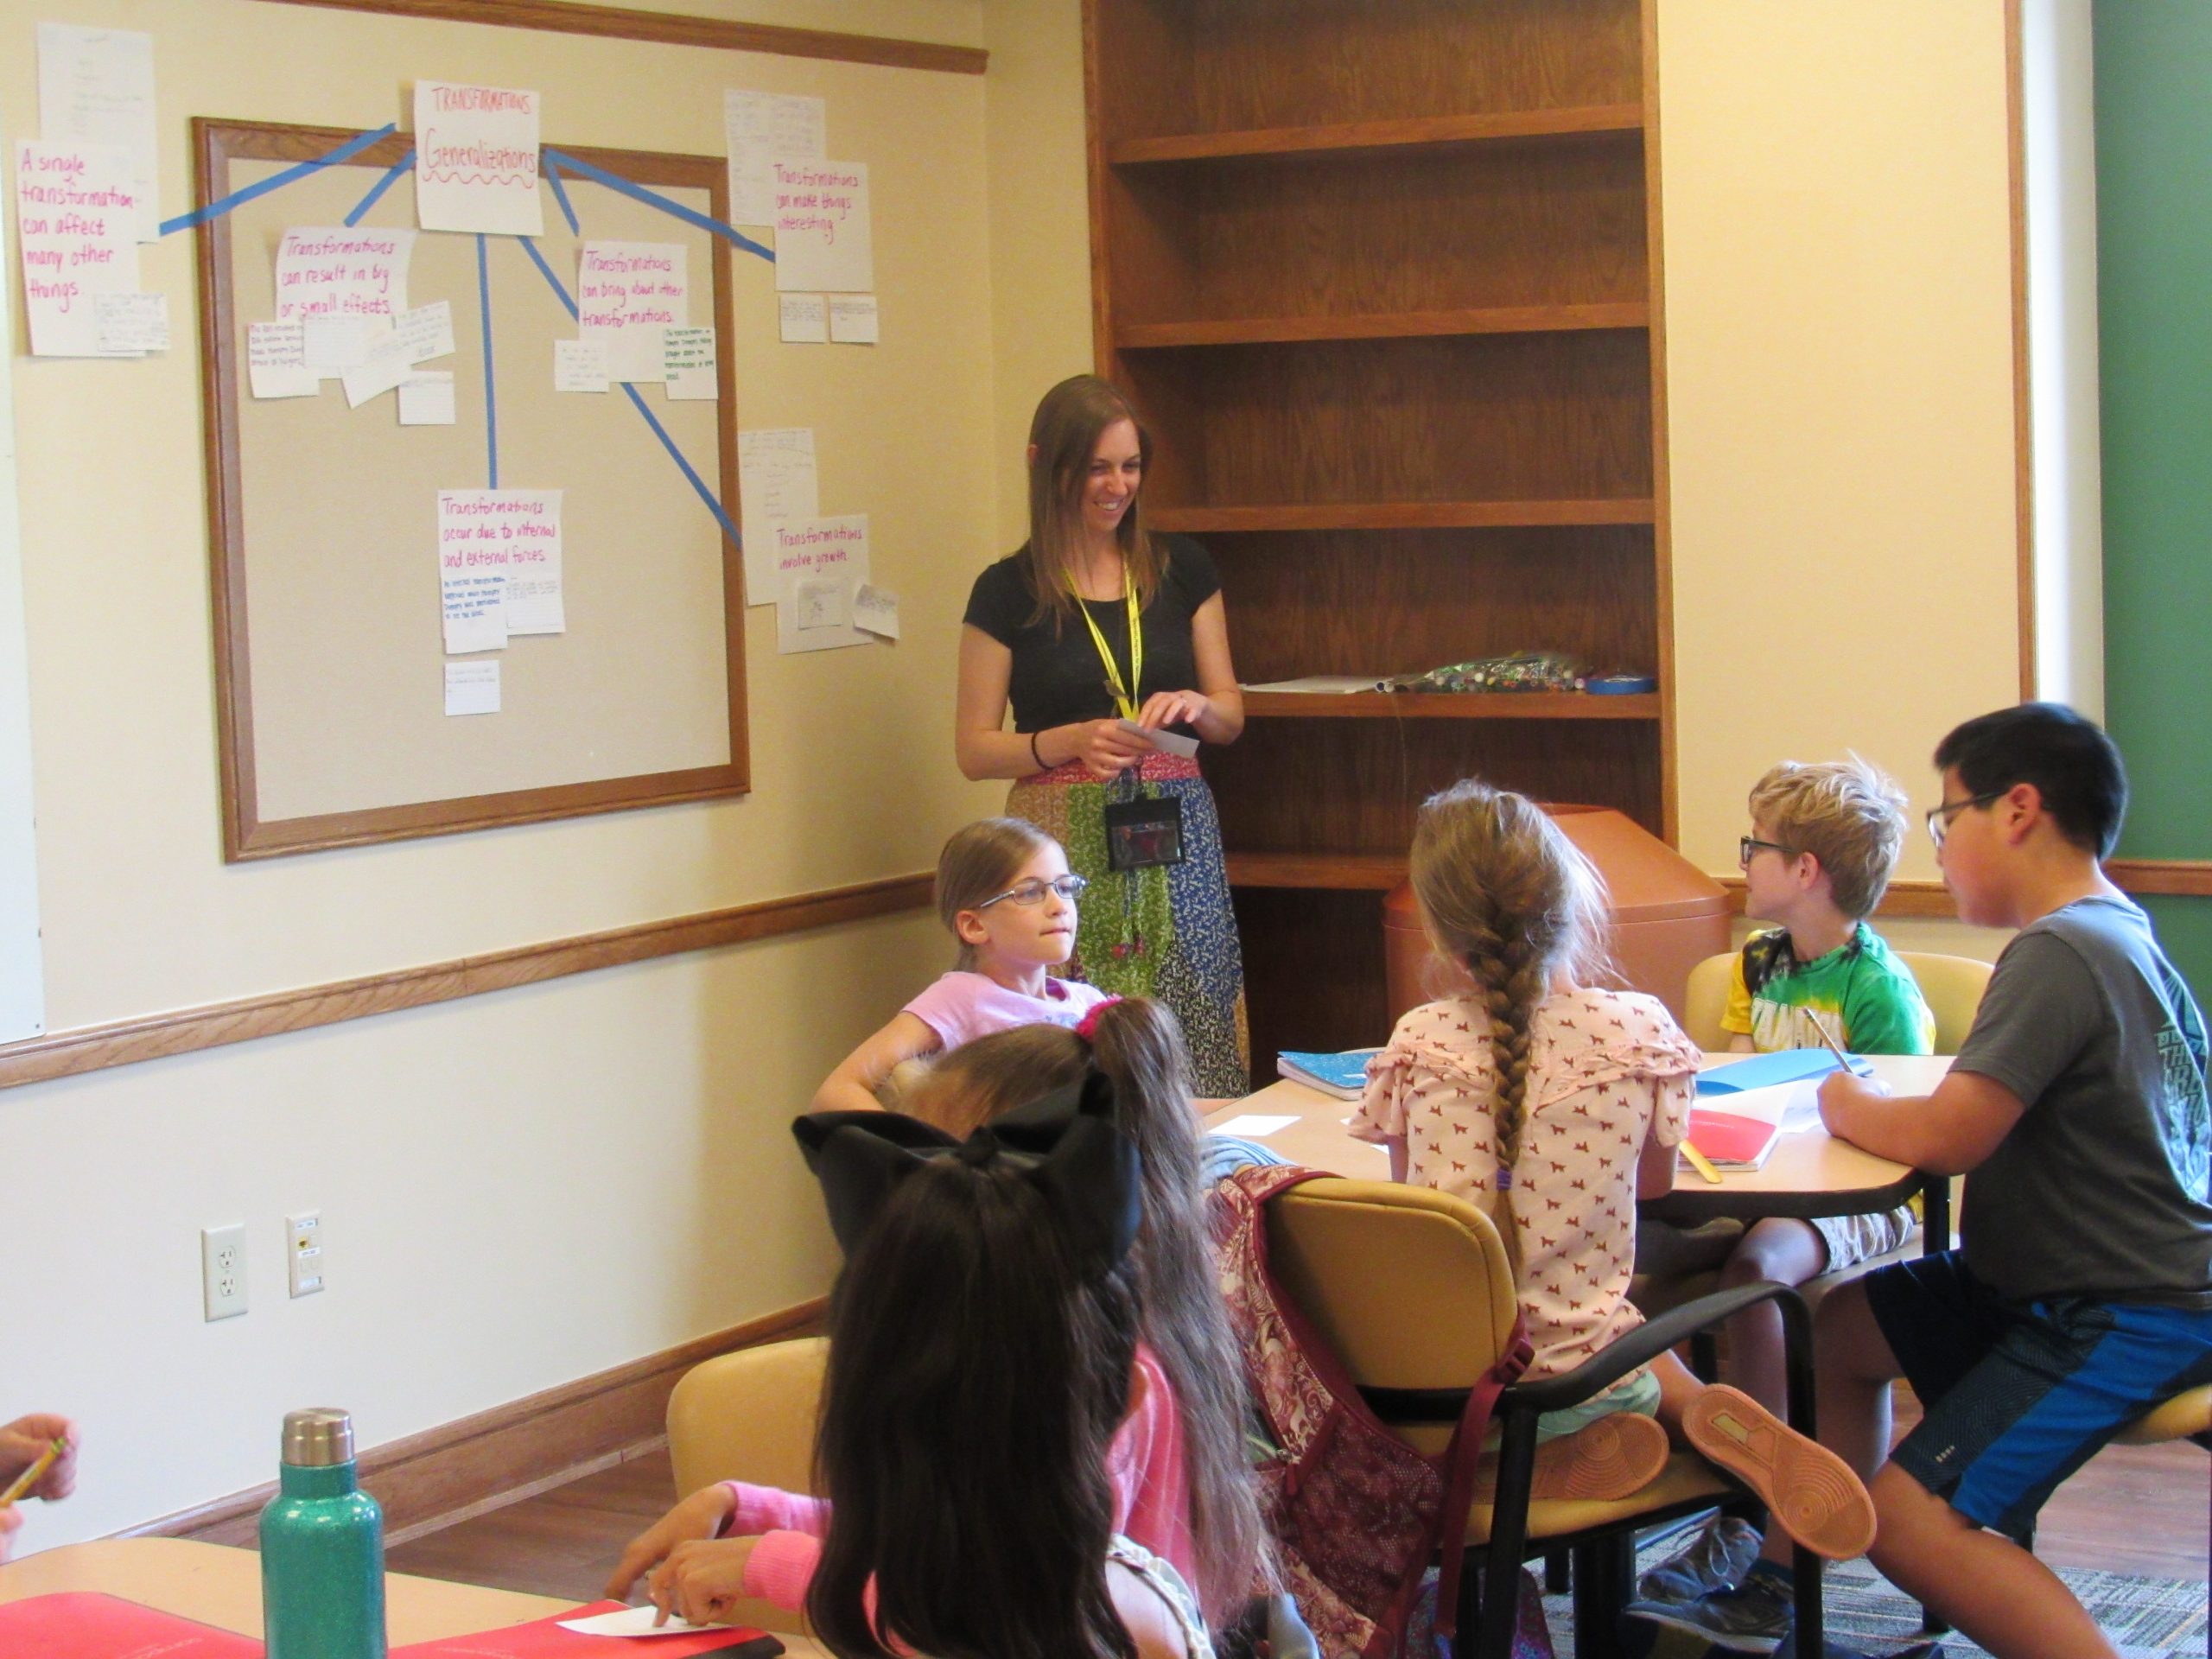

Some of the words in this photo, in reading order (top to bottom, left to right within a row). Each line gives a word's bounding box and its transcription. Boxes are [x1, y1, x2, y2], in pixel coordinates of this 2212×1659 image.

[426, 127, 535, 173] Generalizations
[22, 148, 32, 171] A
[39, 155, 85, 183] single
[773, 163, 858, 187] Transformations
[21, 181, 133, 208] transformation
[793, 194, 817, 208] make
[822, 193, 851, 220] things
[23, 218, 48, 235] can
[55, 213, 105, 236] affect
[27, 250, 62, 273] many
[72, 243, 114, 266] other
[287, 236, 395, 257] Transformations
[586, 250, 672, 273] Transformations
[282, 270, 301, 287] can
[306, 263, 346, 283] result
[353, 268, 365, 281] in
[372, 263, 391, 293] big
[30, 278, 79, 313] things
[280, 303, 294, 318] or
[301, 293, 337, 318] small
[582, 285, 597, 298] can
[601, 282, 626, 308] bring
[632, 280, 654, 295] about
[442, 498, 543, 516] Transformations
[443, 528, 472, 543] occur
[476, 526, 497, 540] due
[499, 525, 513, 540] to
[517, 520, 556, 540] internal
[777, 524, 862, 546] Transformations
[444, 549, 462, 568] and
[467, 548, 508, 566] external
[779, 553, 811, 570] involve
